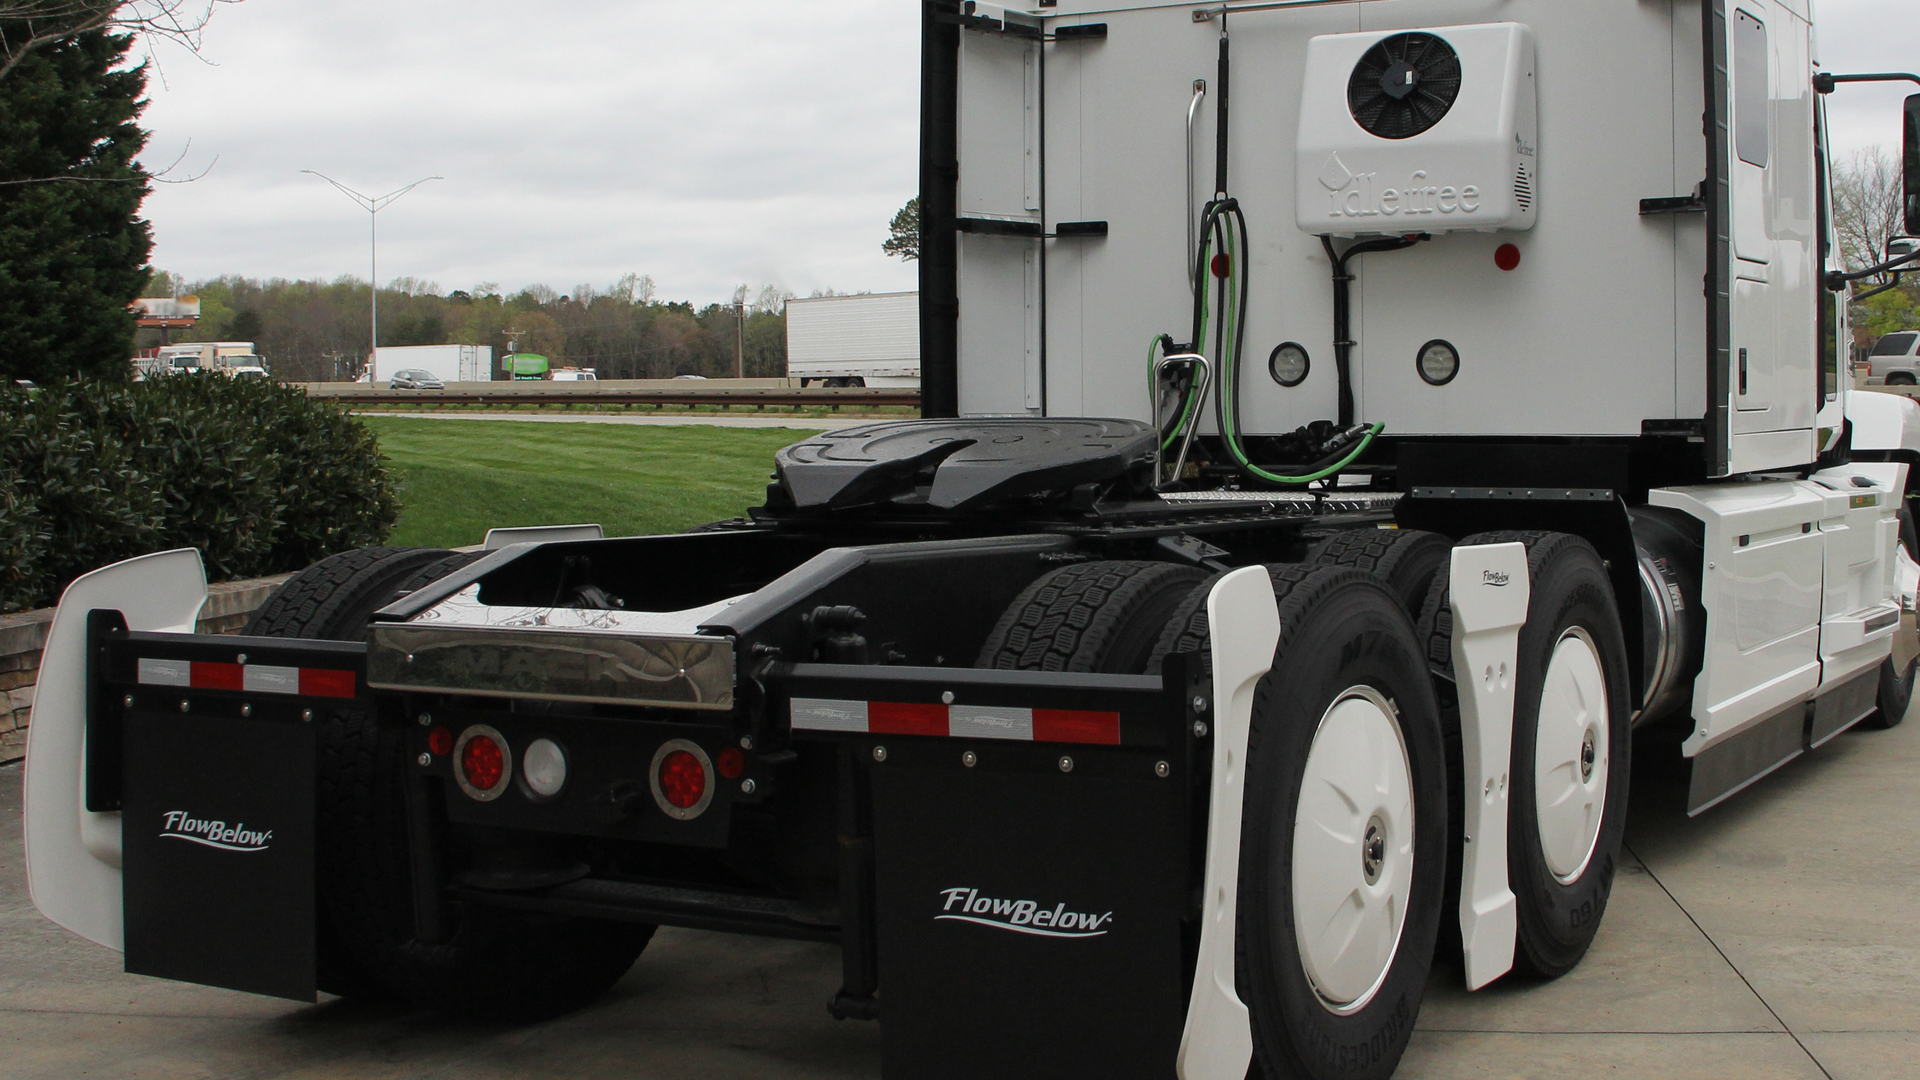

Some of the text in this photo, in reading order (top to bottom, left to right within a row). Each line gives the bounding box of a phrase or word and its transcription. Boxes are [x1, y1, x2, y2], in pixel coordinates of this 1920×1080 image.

[1481, 569, 1511, 584] FlowBelow
[162, 810, 273, 846] FlowBelow
[939, 887, 1113, 931] FlowBelow
